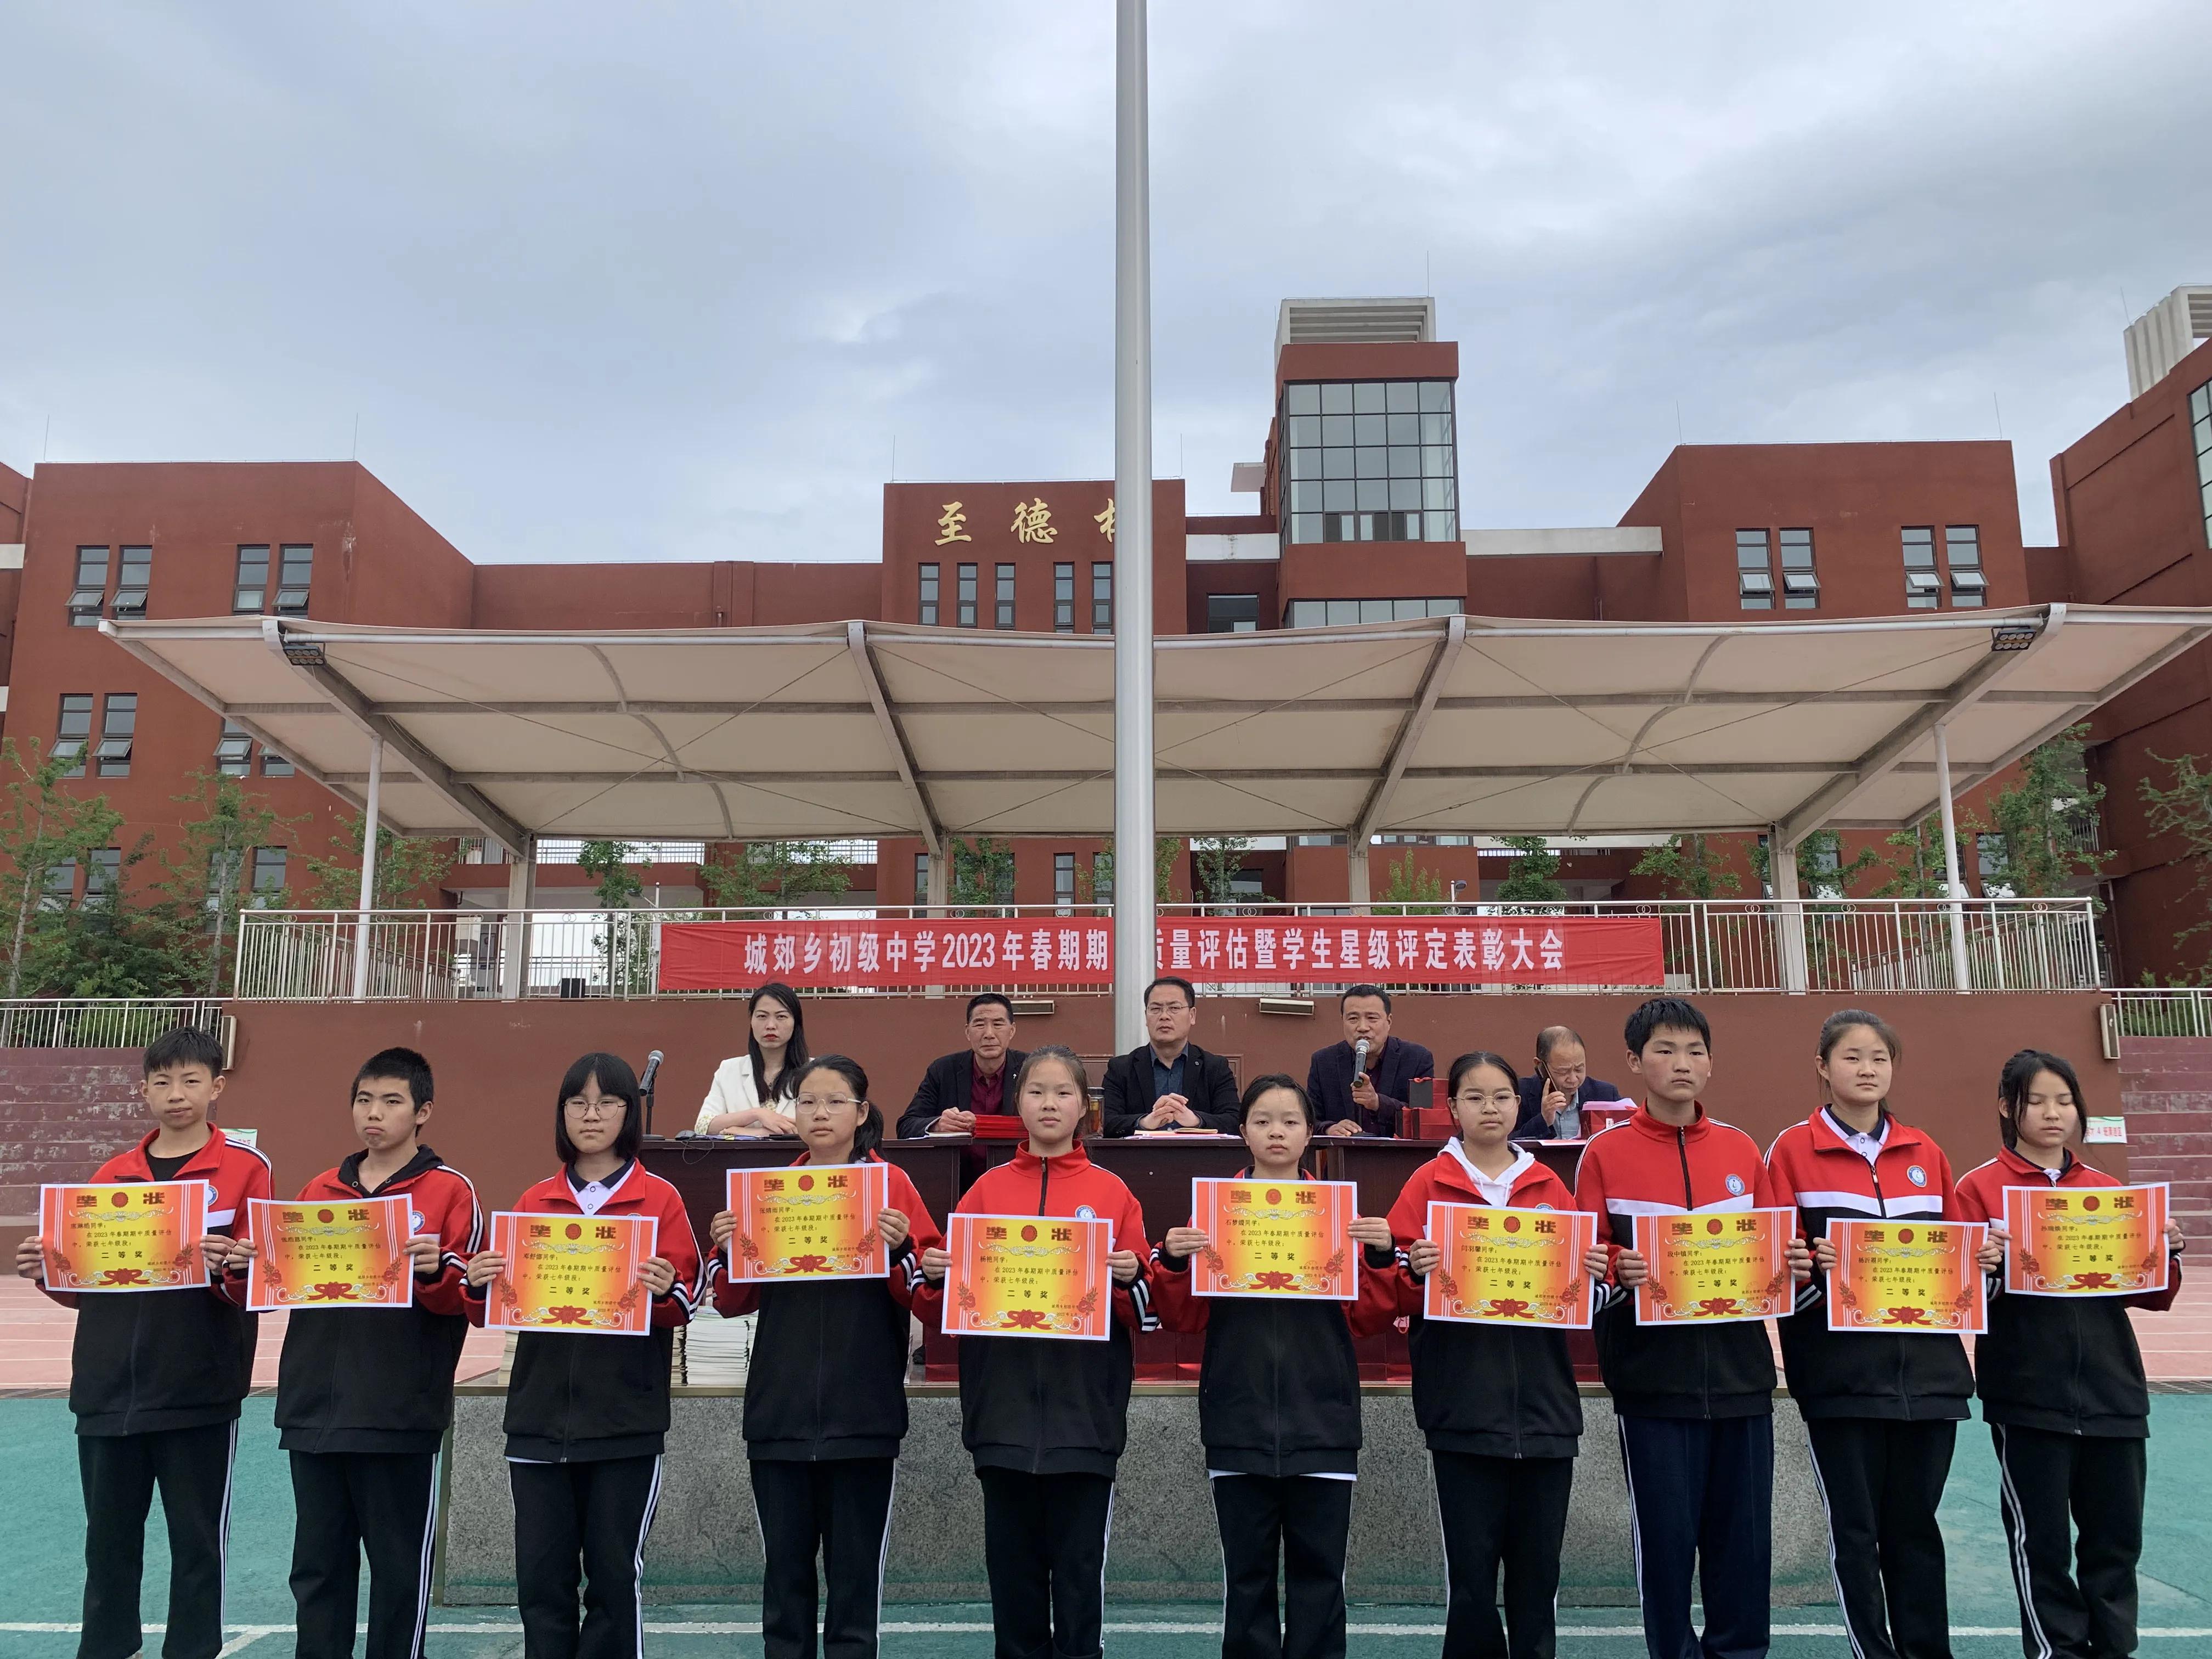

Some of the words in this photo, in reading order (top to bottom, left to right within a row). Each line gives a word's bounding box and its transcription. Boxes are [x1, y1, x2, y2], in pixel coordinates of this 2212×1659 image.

[744, 928, 1562, 975] 城郊乡初级中学2023年春期期量评估暨学生星级评定表彰大会
[788, 1236, 828, 1244] 二等奖
[1255, 1252, 1295, 1261] 二等奖
[1490, 1279, 1531, 1289] 二等奖
[1697, 1279, 1737, 1288] 二等奖
[549, 1286, 590, 1295] 二等奖
[1007, 1290, 1048, 1299] 二等奖
[1886, 1288, 1926, 1296] 二等奖
